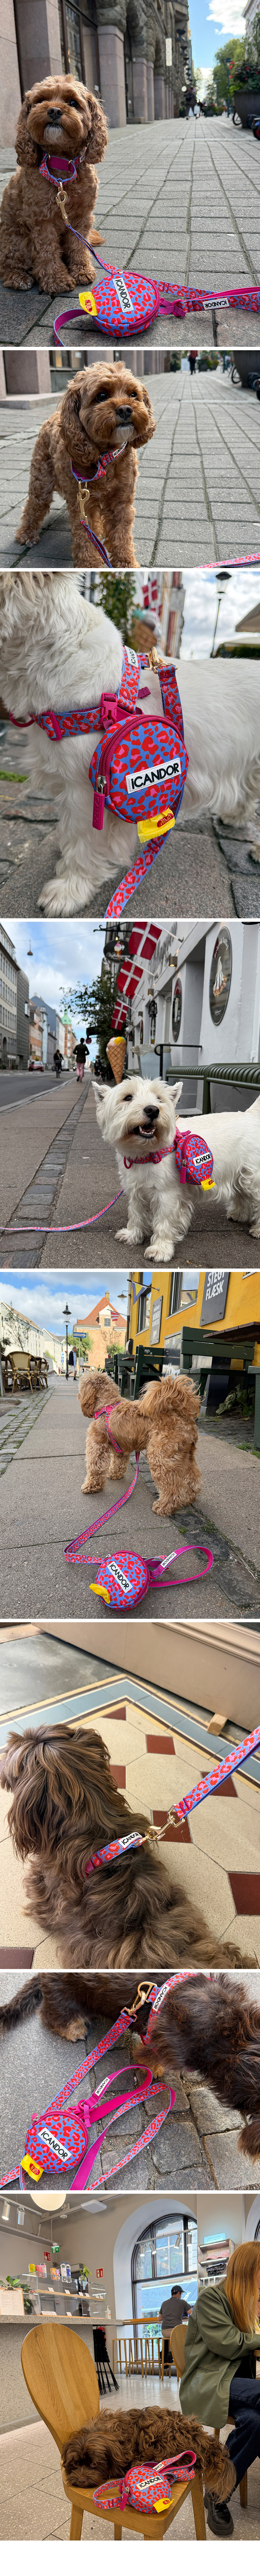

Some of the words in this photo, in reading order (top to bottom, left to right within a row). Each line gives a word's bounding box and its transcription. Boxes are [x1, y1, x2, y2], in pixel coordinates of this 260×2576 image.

[115, 279, 131, 309] iCANDOR
[131, 763, 179, 789] iCANDOR
[205, 1279, 224, 1301] FLÆSK
[109, 1563, 129, 1590] iCANDOR
[121, 1833, 140, 1845] ICANDOR
[41, 2131, 68, 2159] iCANDOR
